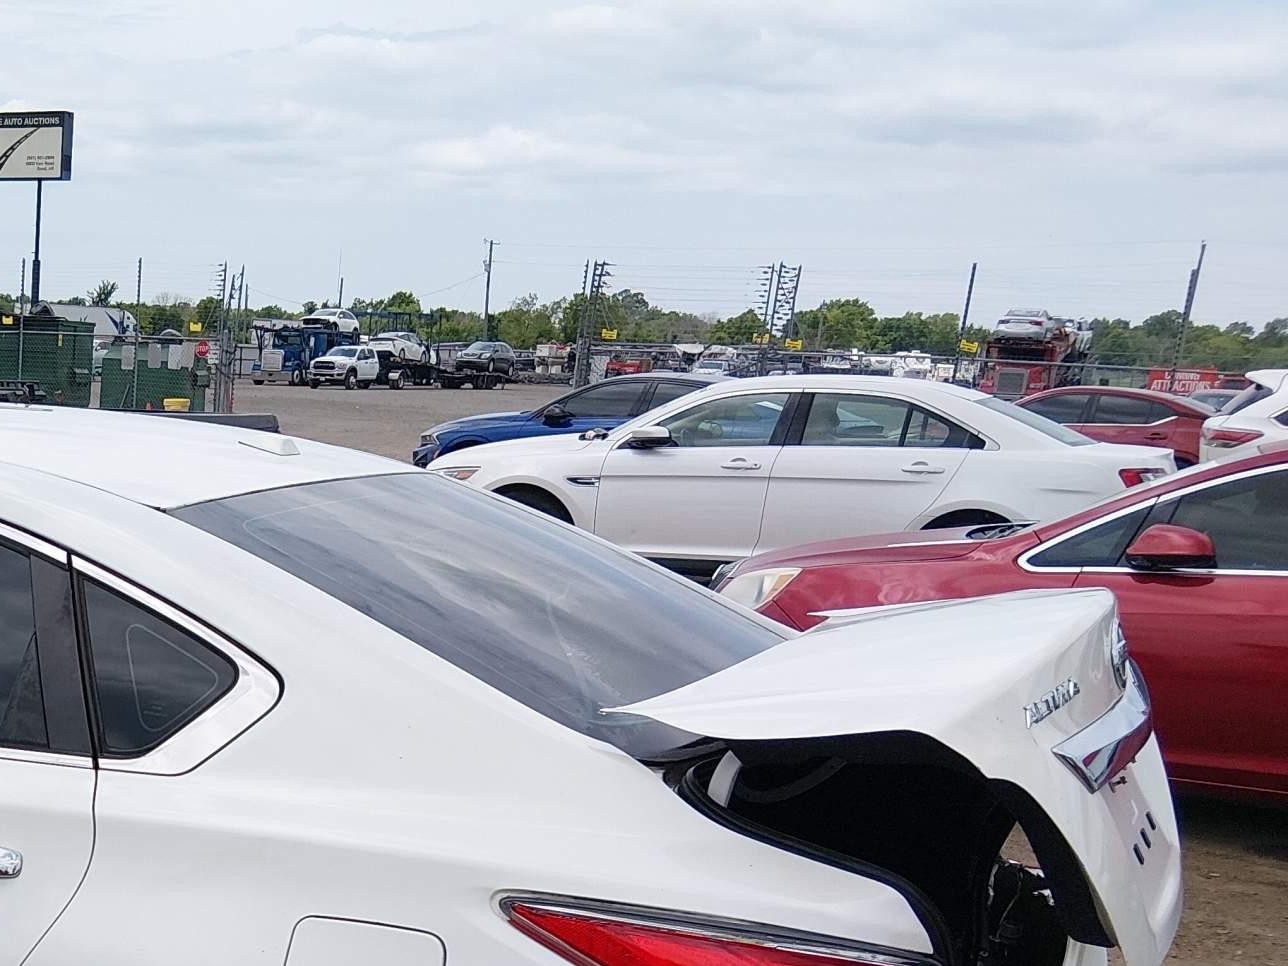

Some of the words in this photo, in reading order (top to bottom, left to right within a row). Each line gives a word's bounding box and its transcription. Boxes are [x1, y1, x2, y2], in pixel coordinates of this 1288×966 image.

[4, 117, 23, 126] AUTO
[24, 116, 60, 126] AUCTIONS
[1023, 678, 1081, 729] ALTIMA
